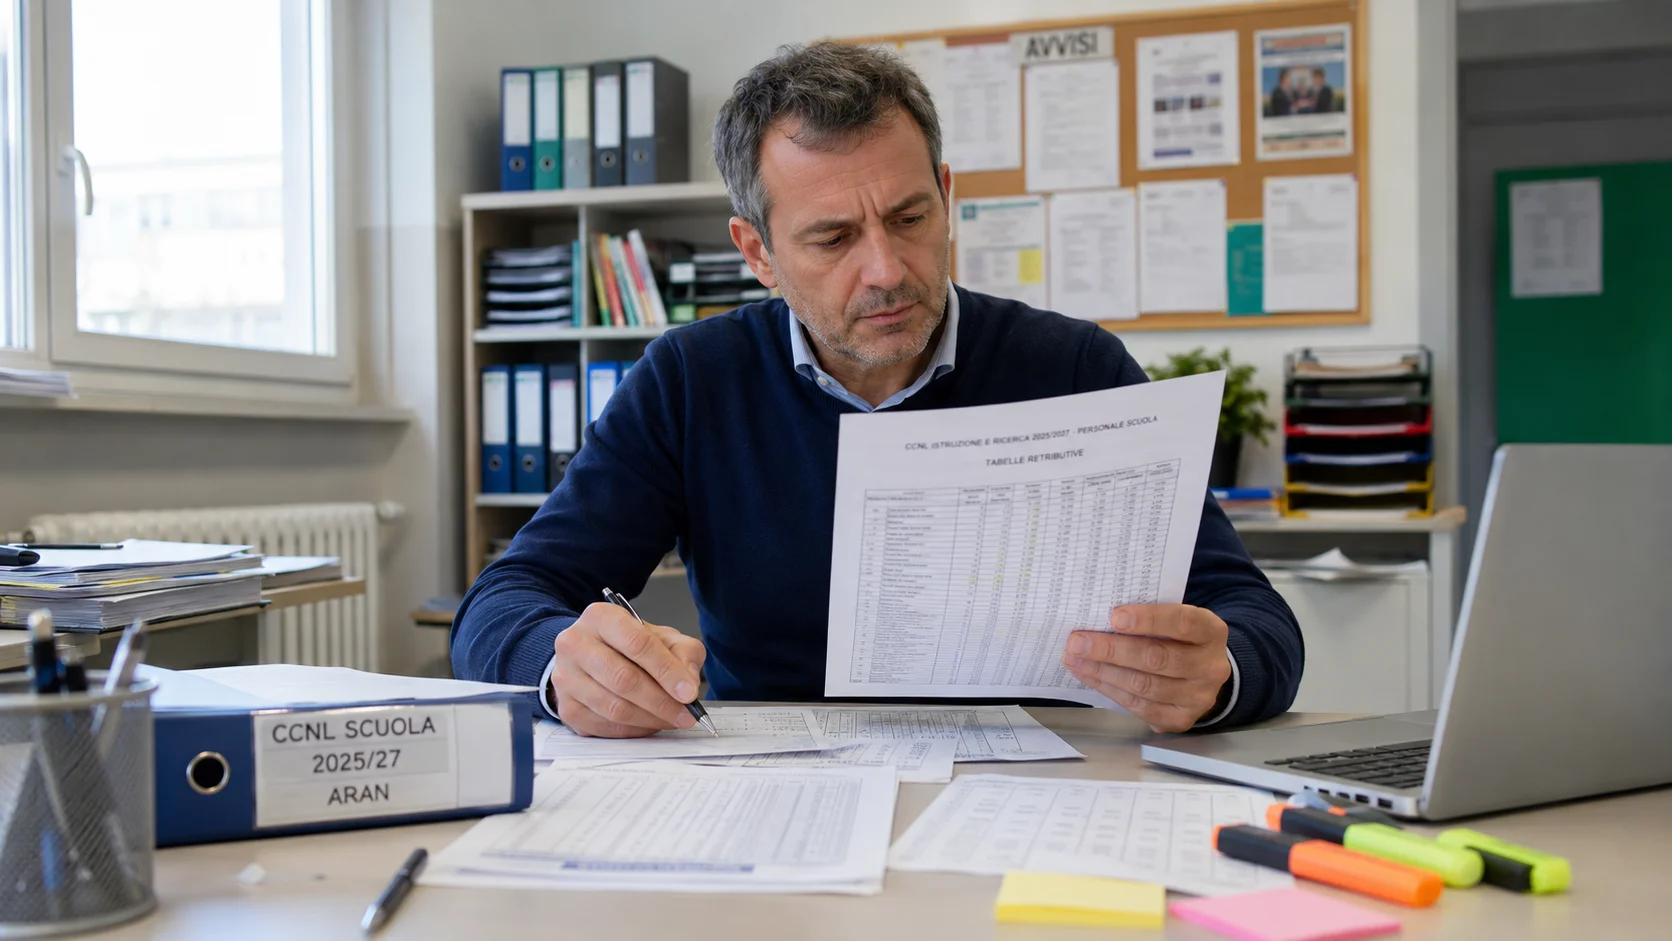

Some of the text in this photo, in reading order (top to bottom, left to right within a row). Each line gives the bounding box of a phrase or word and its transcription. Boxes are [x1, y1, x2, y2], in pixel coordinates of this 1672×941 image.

[1026, 32, 1098, 57] AVVISI
[905, 443, 929, 451] CCNL
[931, 439, 983, 449] ISTRUZIONE
[985, 438, 991, 446] E
[993, 435, 1030, 445] RICERCA
[1032, 429, 1070, 441] 2025/2027
[1077, 421, 1125, 434] PERSONALE
[1127, 415, 1158, 427] SCUOLA
[986, 449, 1084, 467] TABELLE RETRIBUTIVE
[272, 716, 436, 744] CCNL SCUOLA
[312, 750, 401, 774] 2025/27
[328, 783, 390, 806] ARAN
